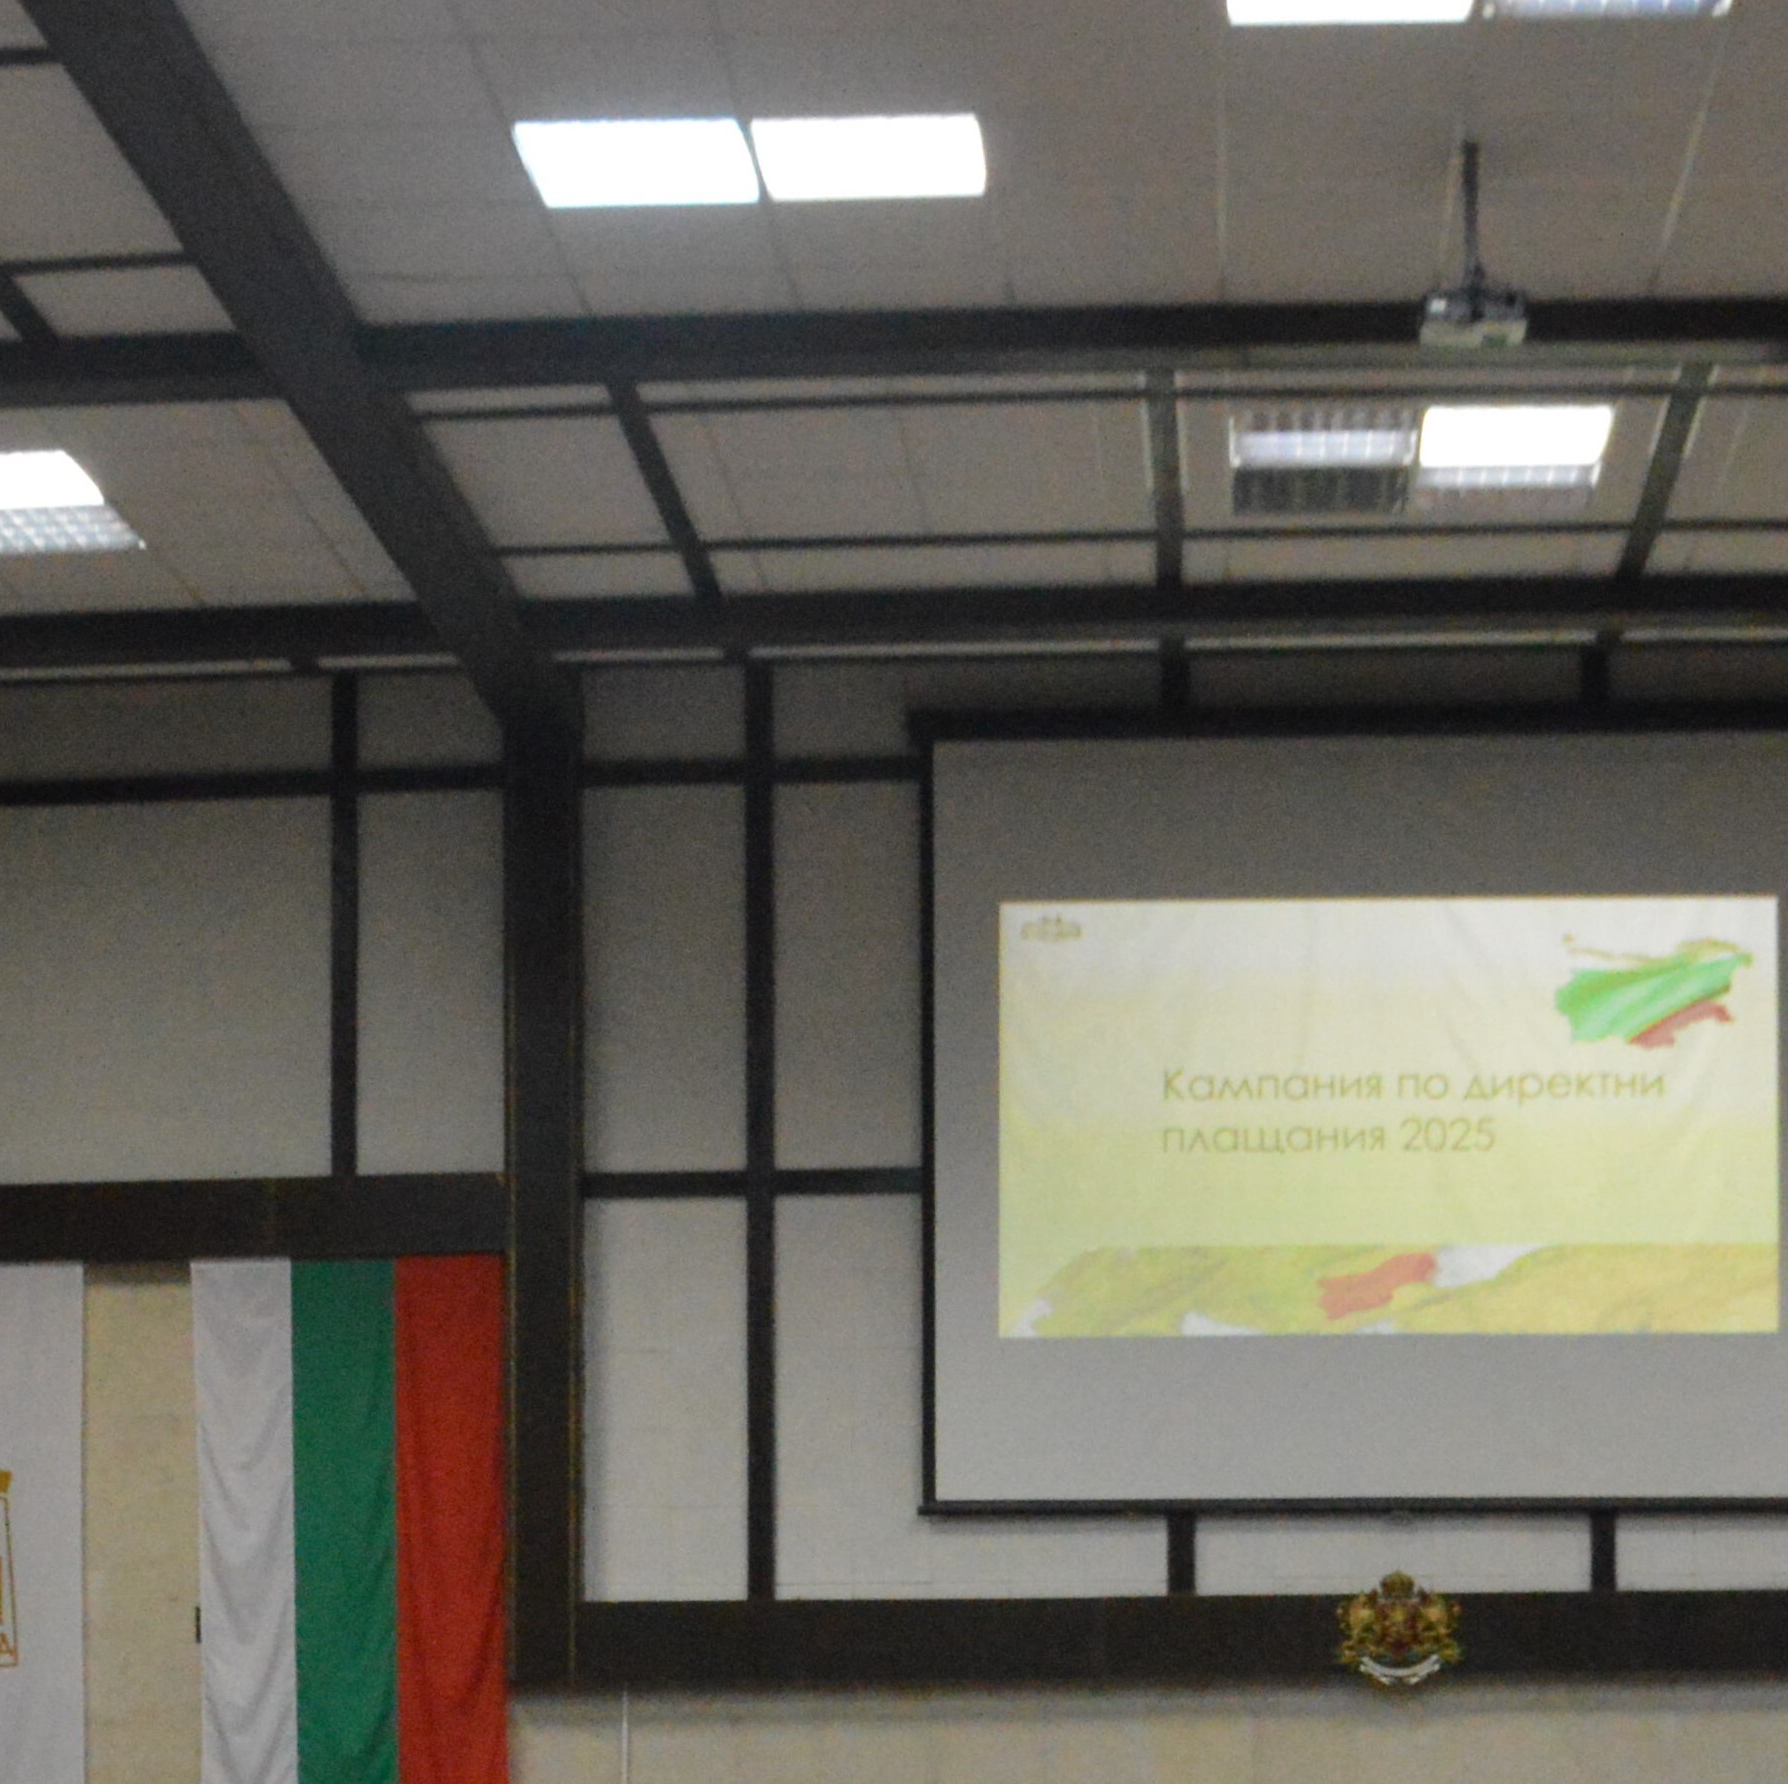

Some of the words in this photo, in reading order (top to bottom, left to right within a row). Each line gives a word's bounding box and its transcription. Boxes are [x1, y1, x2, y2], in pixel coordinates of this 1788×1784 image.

[1162, 1067, 1384, 1102] Кампания
[1397, 1073, 1450, 1101] по
[1463, 1072, 1667, 1107] директни
[1162, 1126, 1386, 1154] плащания
[1399, 1116, 1497, 1152] 2025
